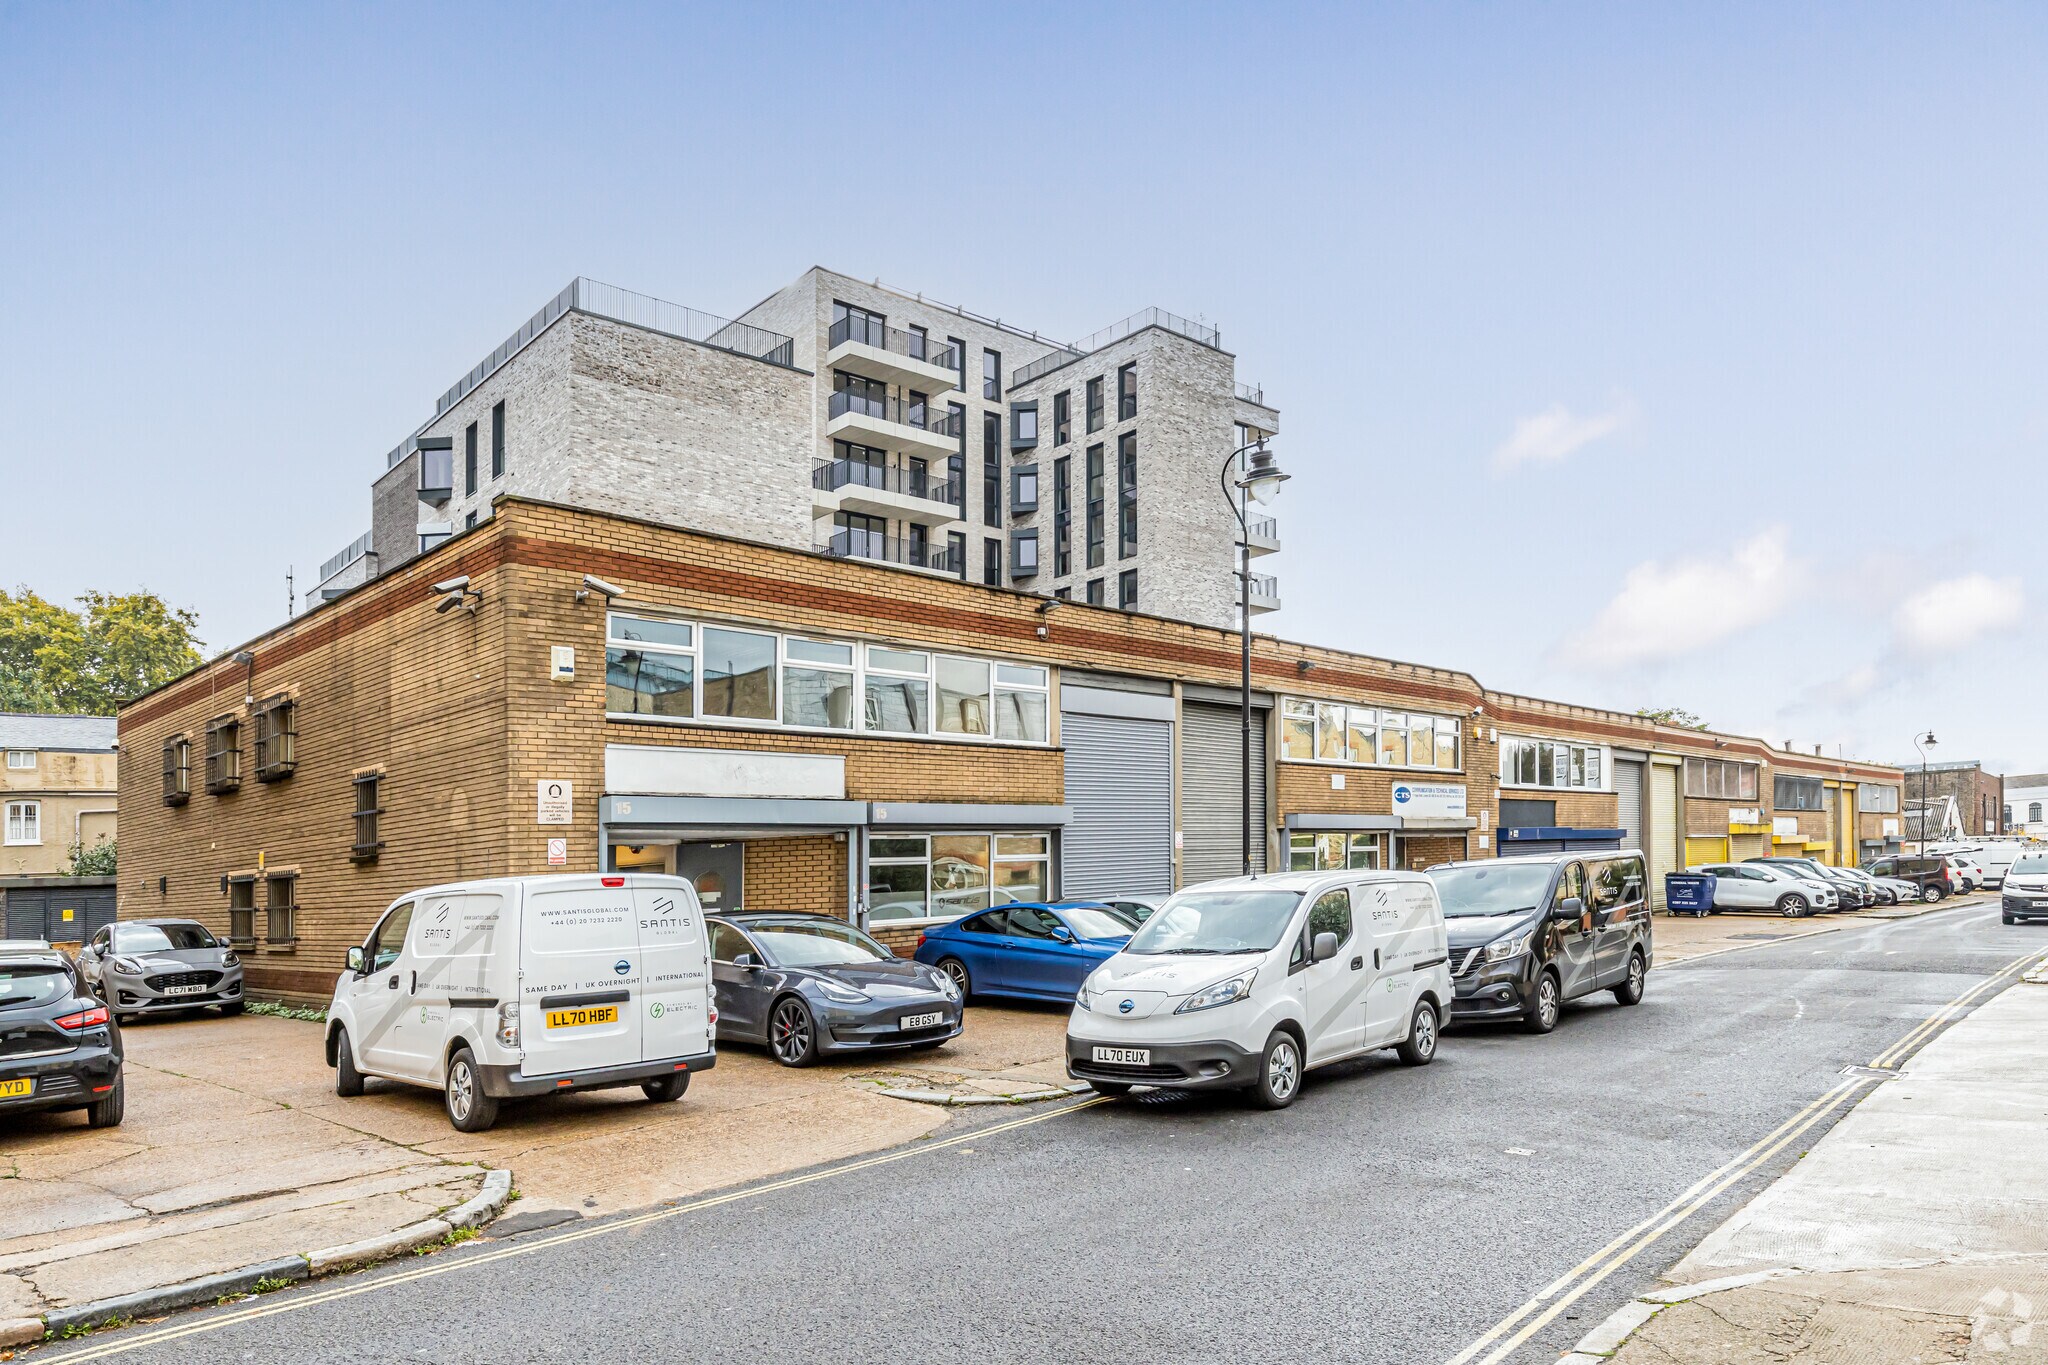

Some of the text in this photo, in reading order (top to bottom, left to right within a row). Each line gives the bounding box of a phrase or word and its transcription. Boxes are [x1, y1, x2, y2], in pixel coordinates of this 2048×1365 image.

[615, 801, 632, 815] 15
[876, 808, 888, 820] 15
[1600, 886, 1618, 895] SANTIS
[541, 907, 629, 917] WWW.SANTISGLOBAL.COM
[1372, 910, 1398, 920] SANTIS
[566, 918, 577, 926] (0)
[640, 918, 691, 929] SANTIS
[424, 929, 451, 939] SANTIS
[525, 985, 548, 993] SAME
[598, 977, 640, 987] OVERNIGHT
[656, 972, 704, 982] INTERNATIONAL
[553, 1008, 613, 1026] LL70 HBF
[910, 1014, 936, 1027] E8 GSY
[1098, 1049, 1145, 1063] LL70 EUX
[0, 1081, 24, 1094] YD
